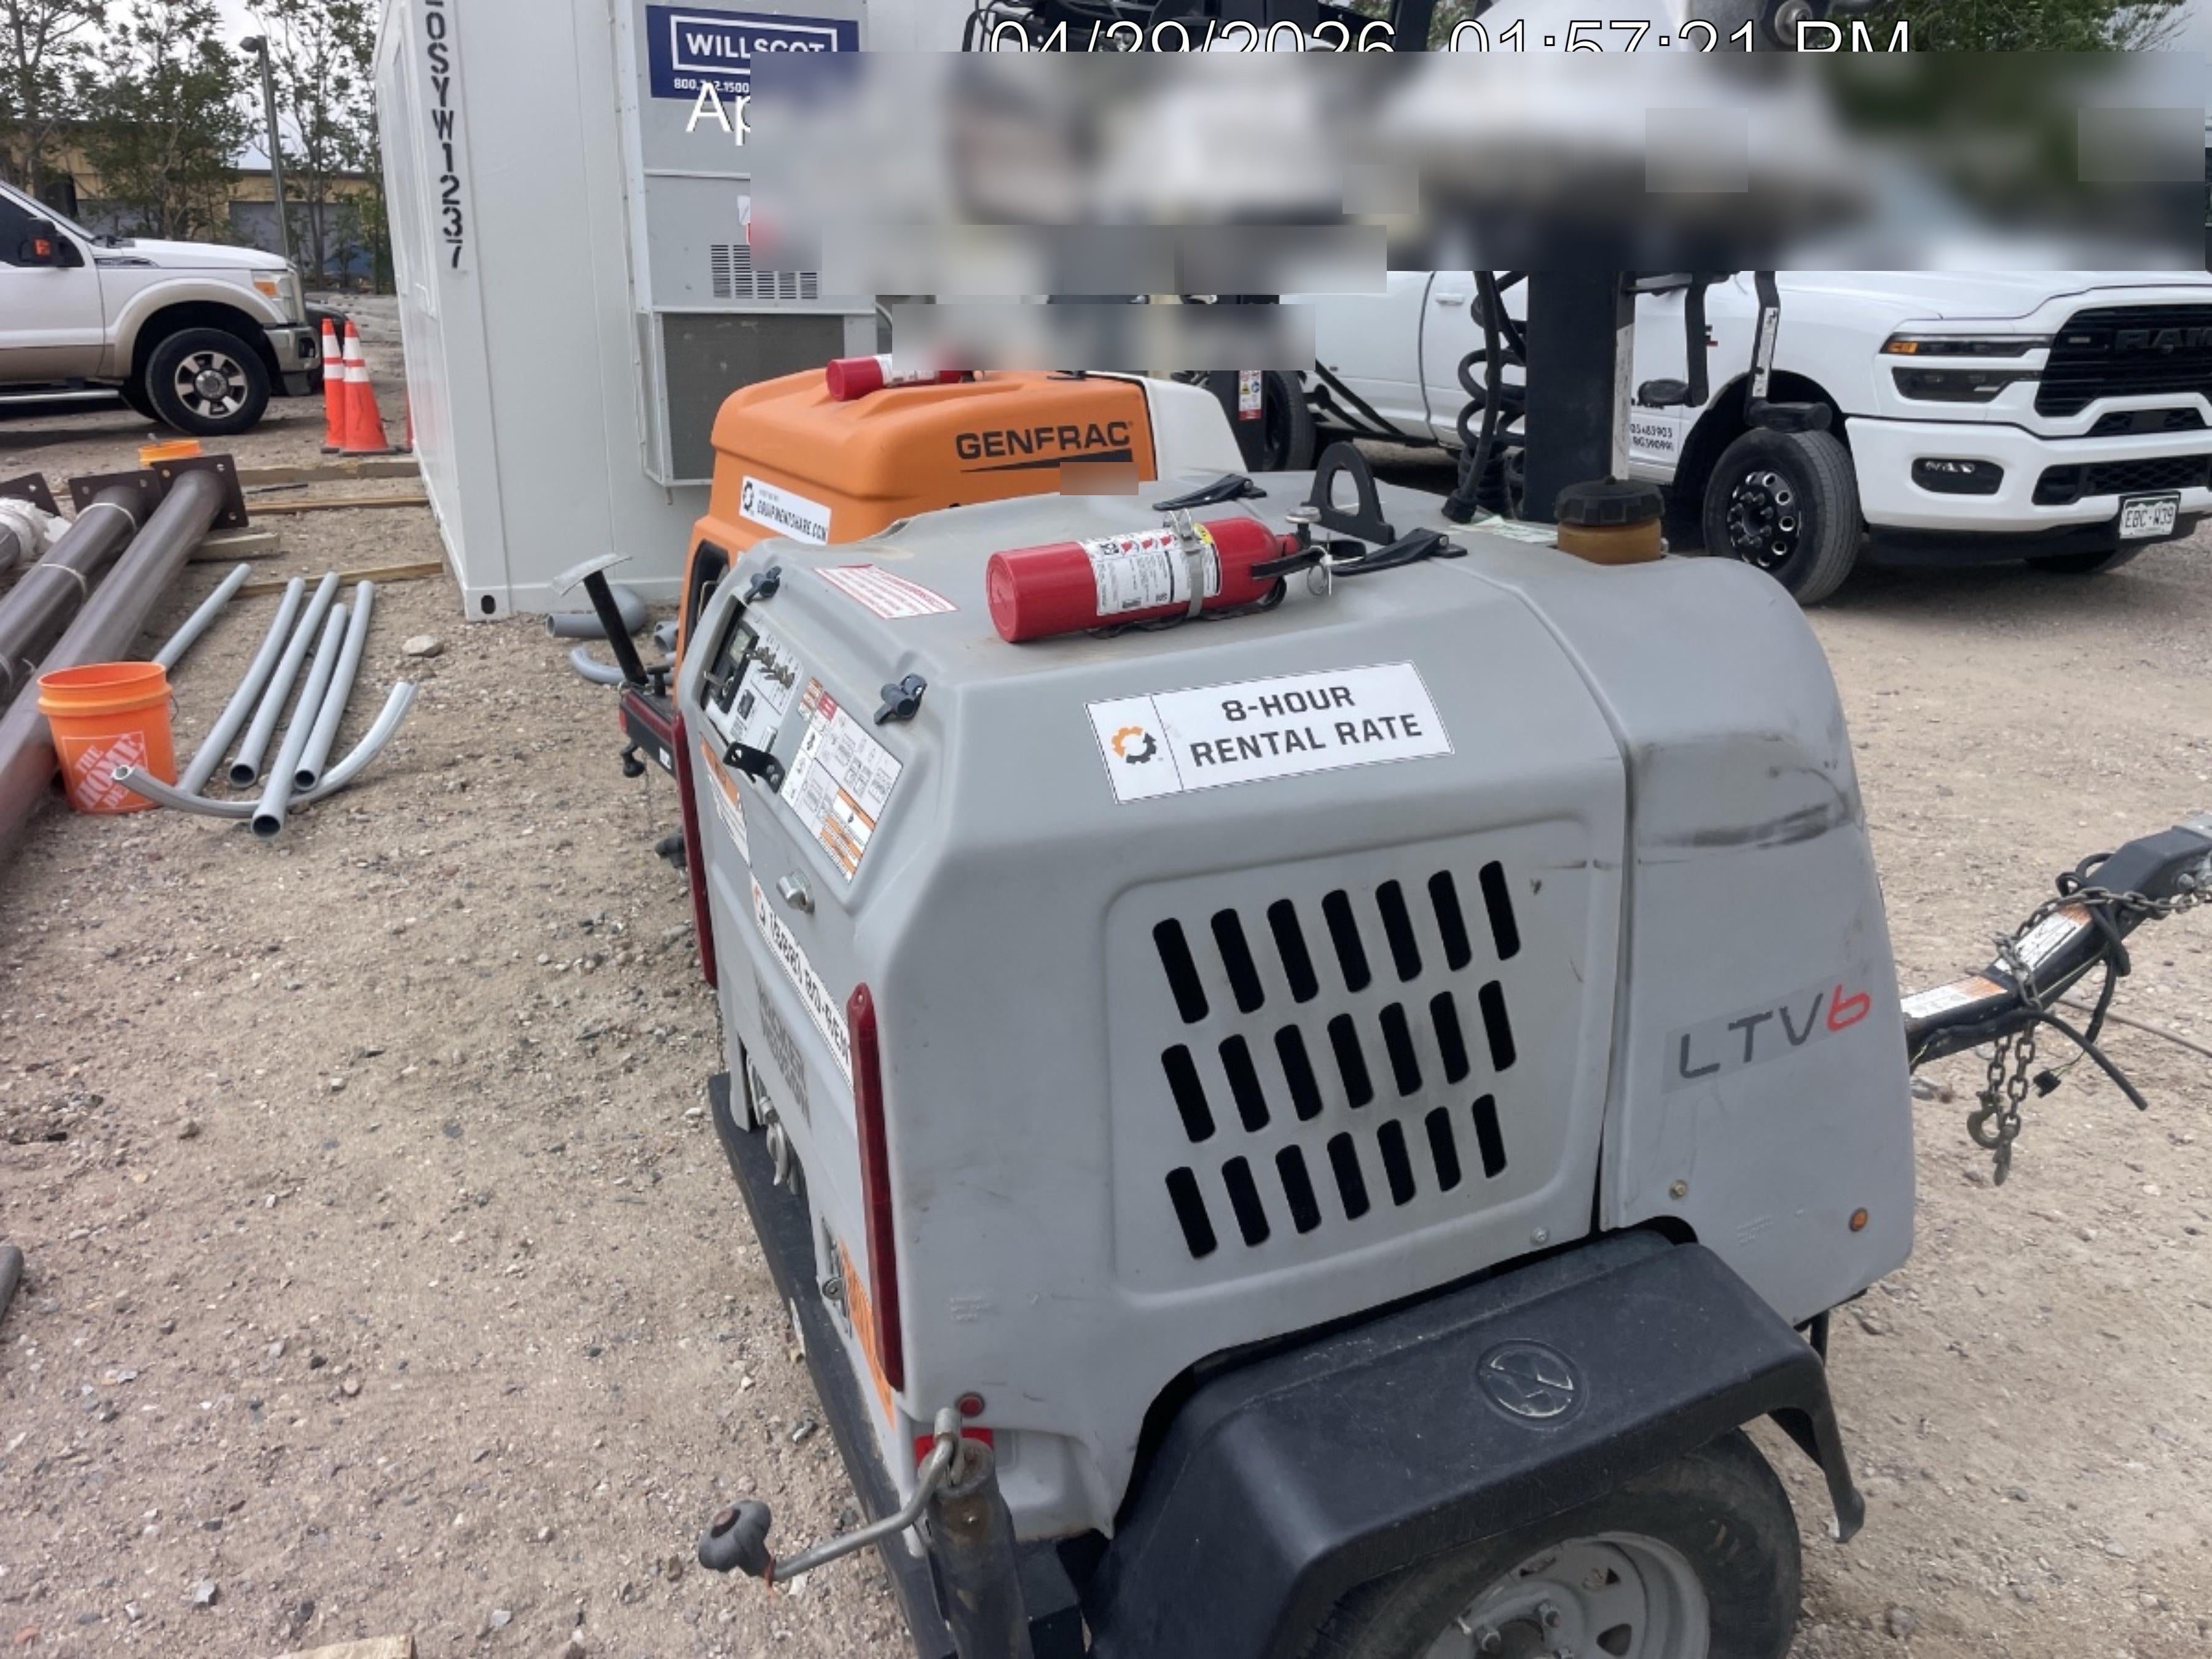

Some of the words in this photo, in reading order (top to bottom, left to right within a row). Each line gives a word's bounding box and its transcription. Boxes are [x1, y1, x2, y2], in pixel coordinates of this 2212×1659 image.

[1222, 686, 1355, 721] 8-HOUR
[1190, 727, 1327, 767] RENTAL
[1334, 713, 1422, 746] RATE
[1679, 984, 1871, 1079] LTV6
